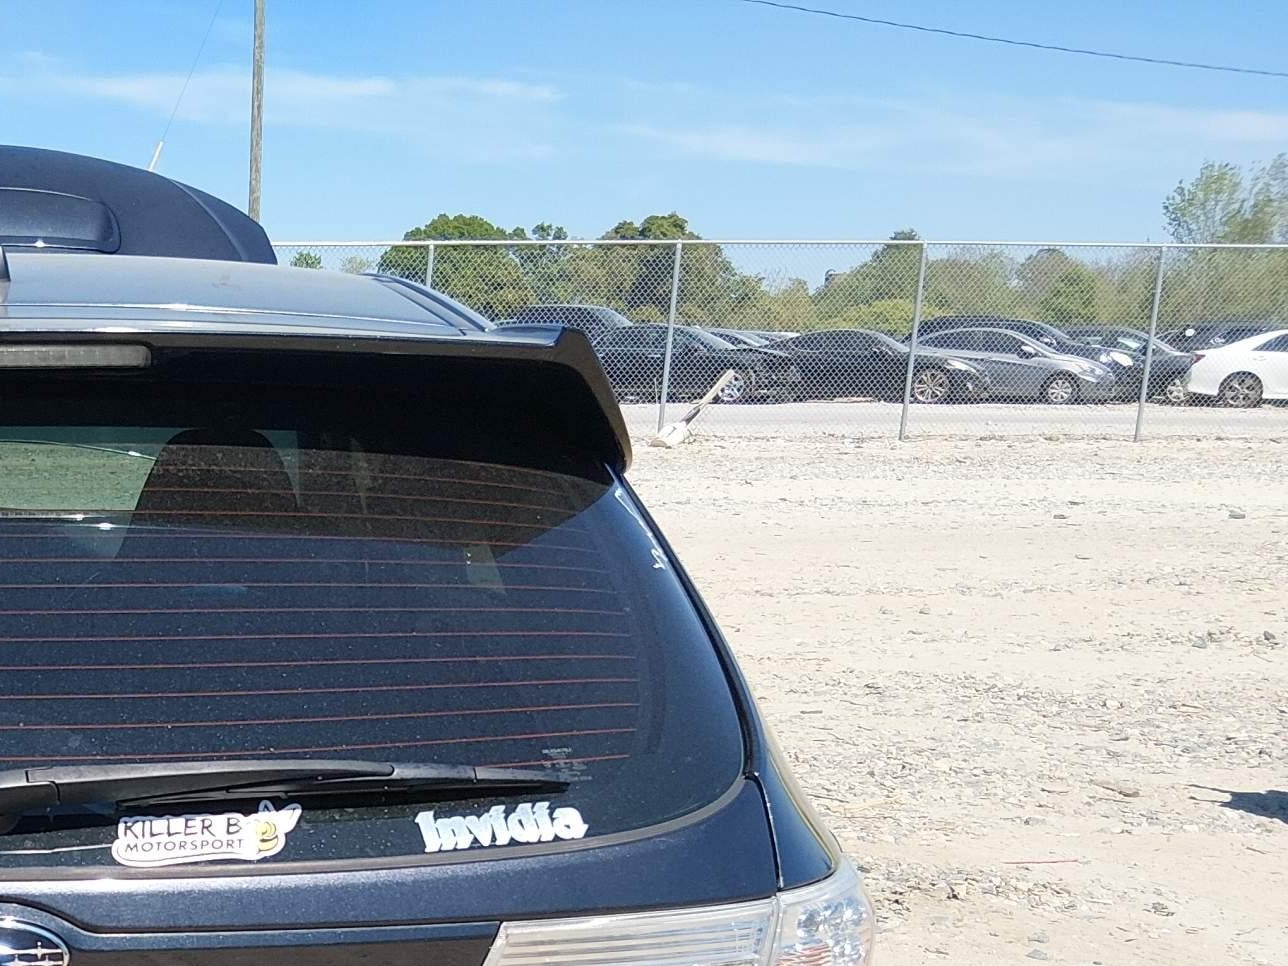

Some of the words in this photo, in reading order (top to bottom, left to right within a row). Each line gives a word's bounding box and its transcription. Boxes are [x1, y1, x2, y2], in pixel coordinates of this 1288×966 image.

[124, 817, 215, 839] KILLER
[227, 817, 242, 834] B
[125, 838, 244, 852] MOTORSPORT
